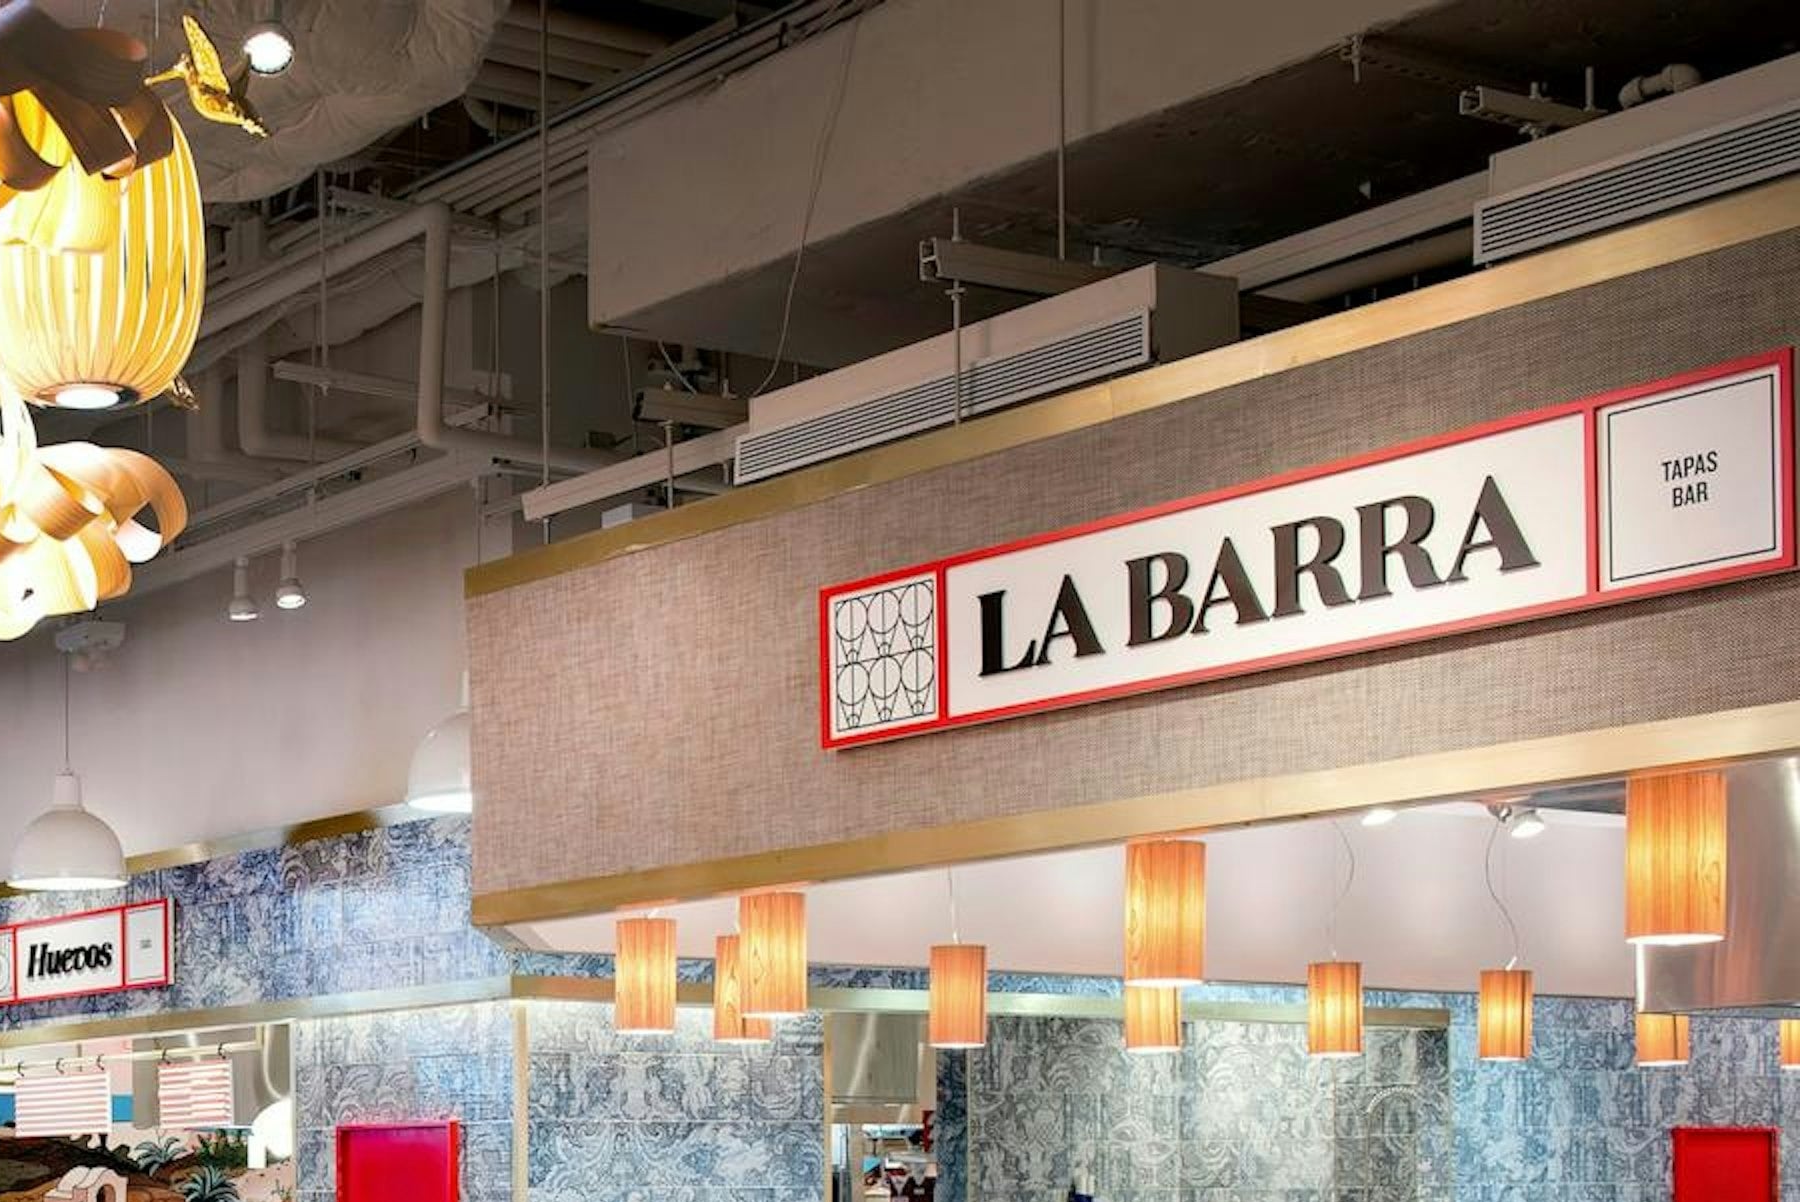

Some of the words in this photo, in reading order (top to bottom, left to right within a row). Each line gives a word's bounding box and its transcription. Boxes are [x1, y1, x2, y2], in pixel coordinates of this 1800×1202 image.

[1661, 450, 1718, 482] TAPAS
[1672, 481, 1708, 508] BAR
[978, 573, 1105, 678] LA
[1126, 474, 1541, 647] BARRA
[27, 941, 113, 979] Huevos
